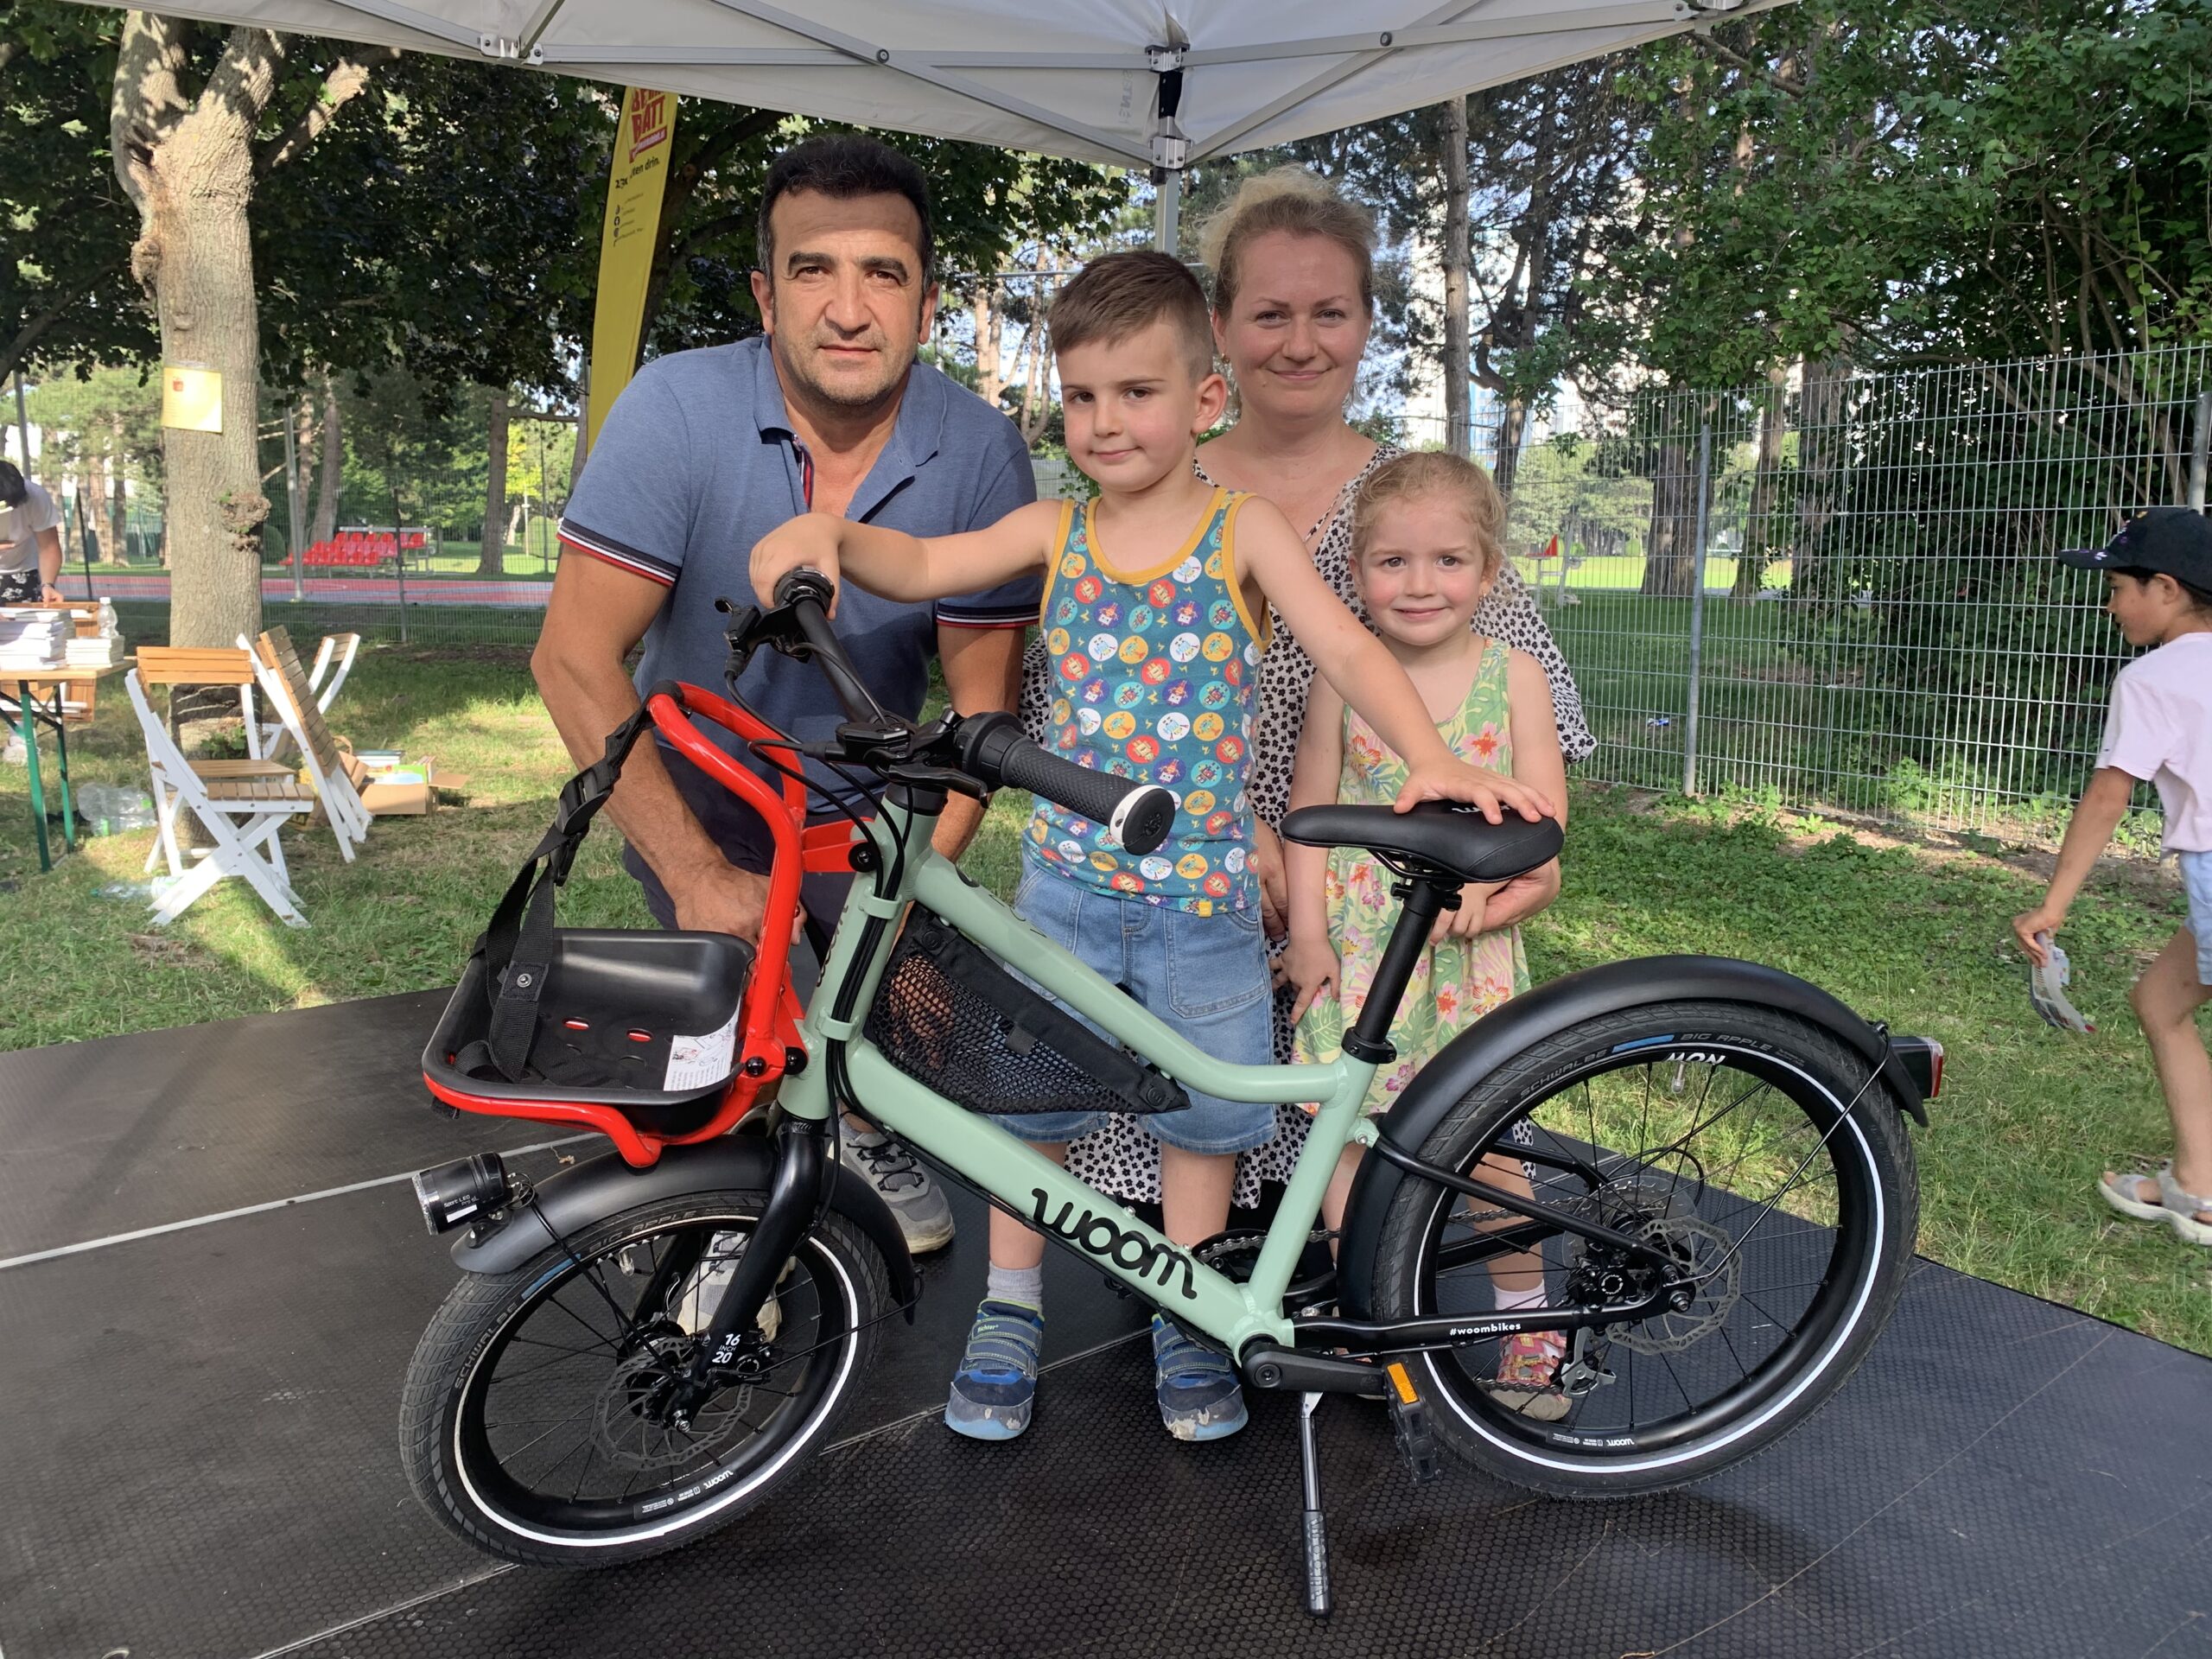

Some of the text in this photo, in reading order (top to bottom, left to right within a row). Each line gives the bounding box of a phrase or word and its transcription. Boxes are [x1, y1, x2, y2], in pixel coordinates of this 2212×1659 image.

[1520, 1049, 1607, 1099] SCHWALBE
[1716, 1034, 1773, 1052] APPLE
[1032, 1188, 1198, 1300] woom
[454, 1302, 518, 1389] SCHWALBE
[589, 1231, 624, 1252] BIG
[632, 1210, 697, 1233] APPLE
[1449, 1323, 1522, 1336] #woombikes
[726, 1333, 741, 1345] 16
[712, 1351, 733, 1363] 20
[1606, 1438, 1635, 1446] woom
[703, 1470, 734, 1489] woom
